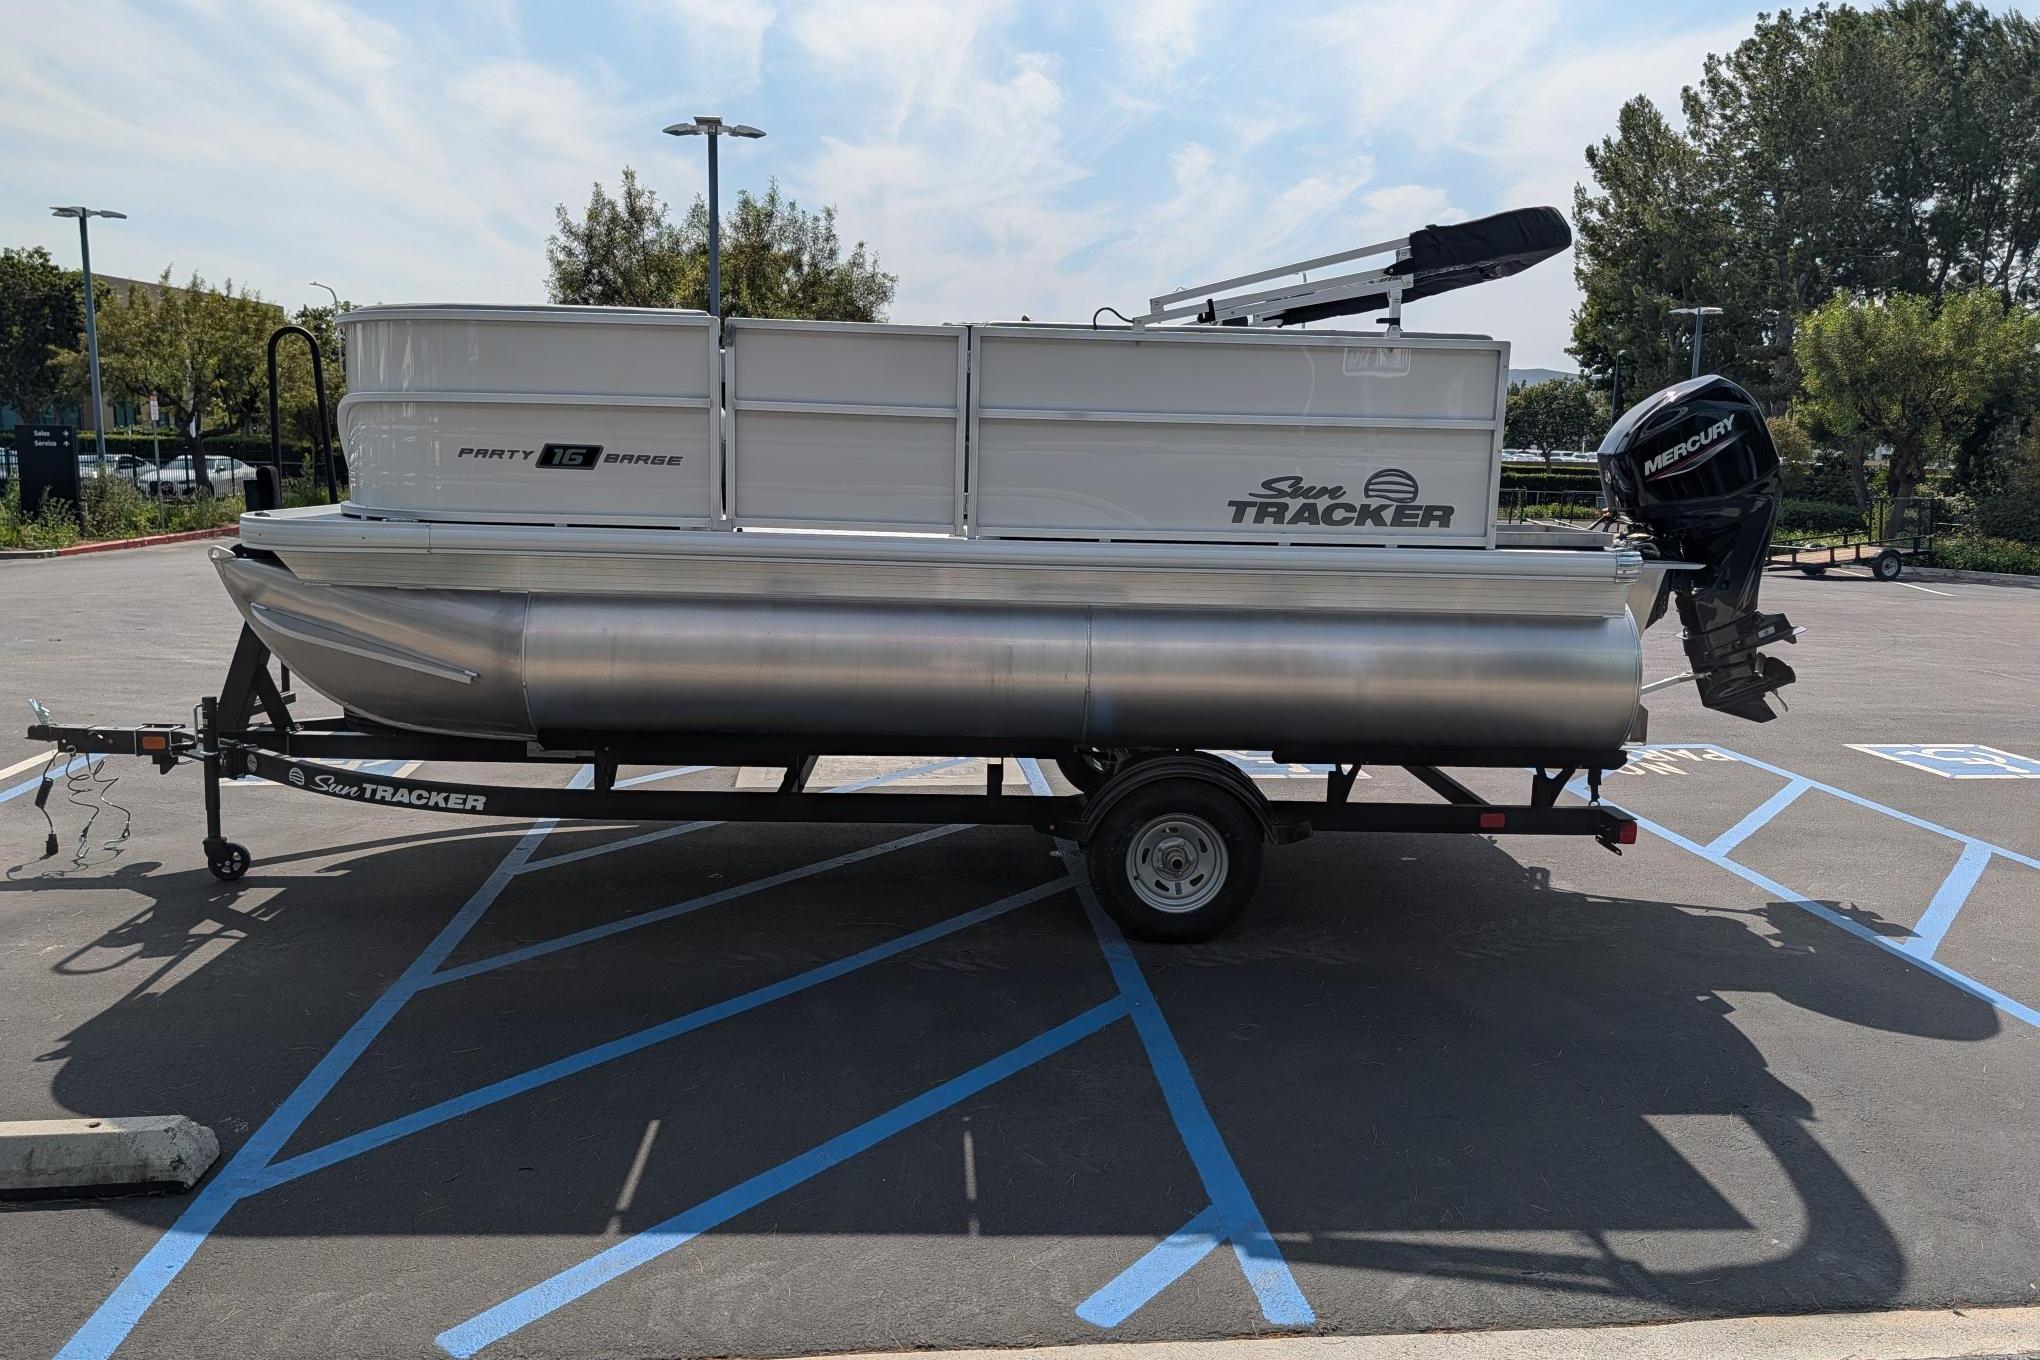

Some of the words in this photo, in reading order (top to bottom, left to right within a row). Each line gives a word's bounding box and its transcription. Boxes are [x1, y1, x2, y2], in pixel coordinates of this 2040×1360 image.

[457, 447, 535, 461] PARTY
[549, 448, 586, 465] 16
[603, 453, 684, 466] BARGE
[1644, 413, 1736, 476] MERCURY
[1248, 475, 1347, 500] Sun
[1227, 499, 1455, 529] TRACKER
[309, 775, 361, 797] Sun
[361, 783, 487, 811] TRACKER
